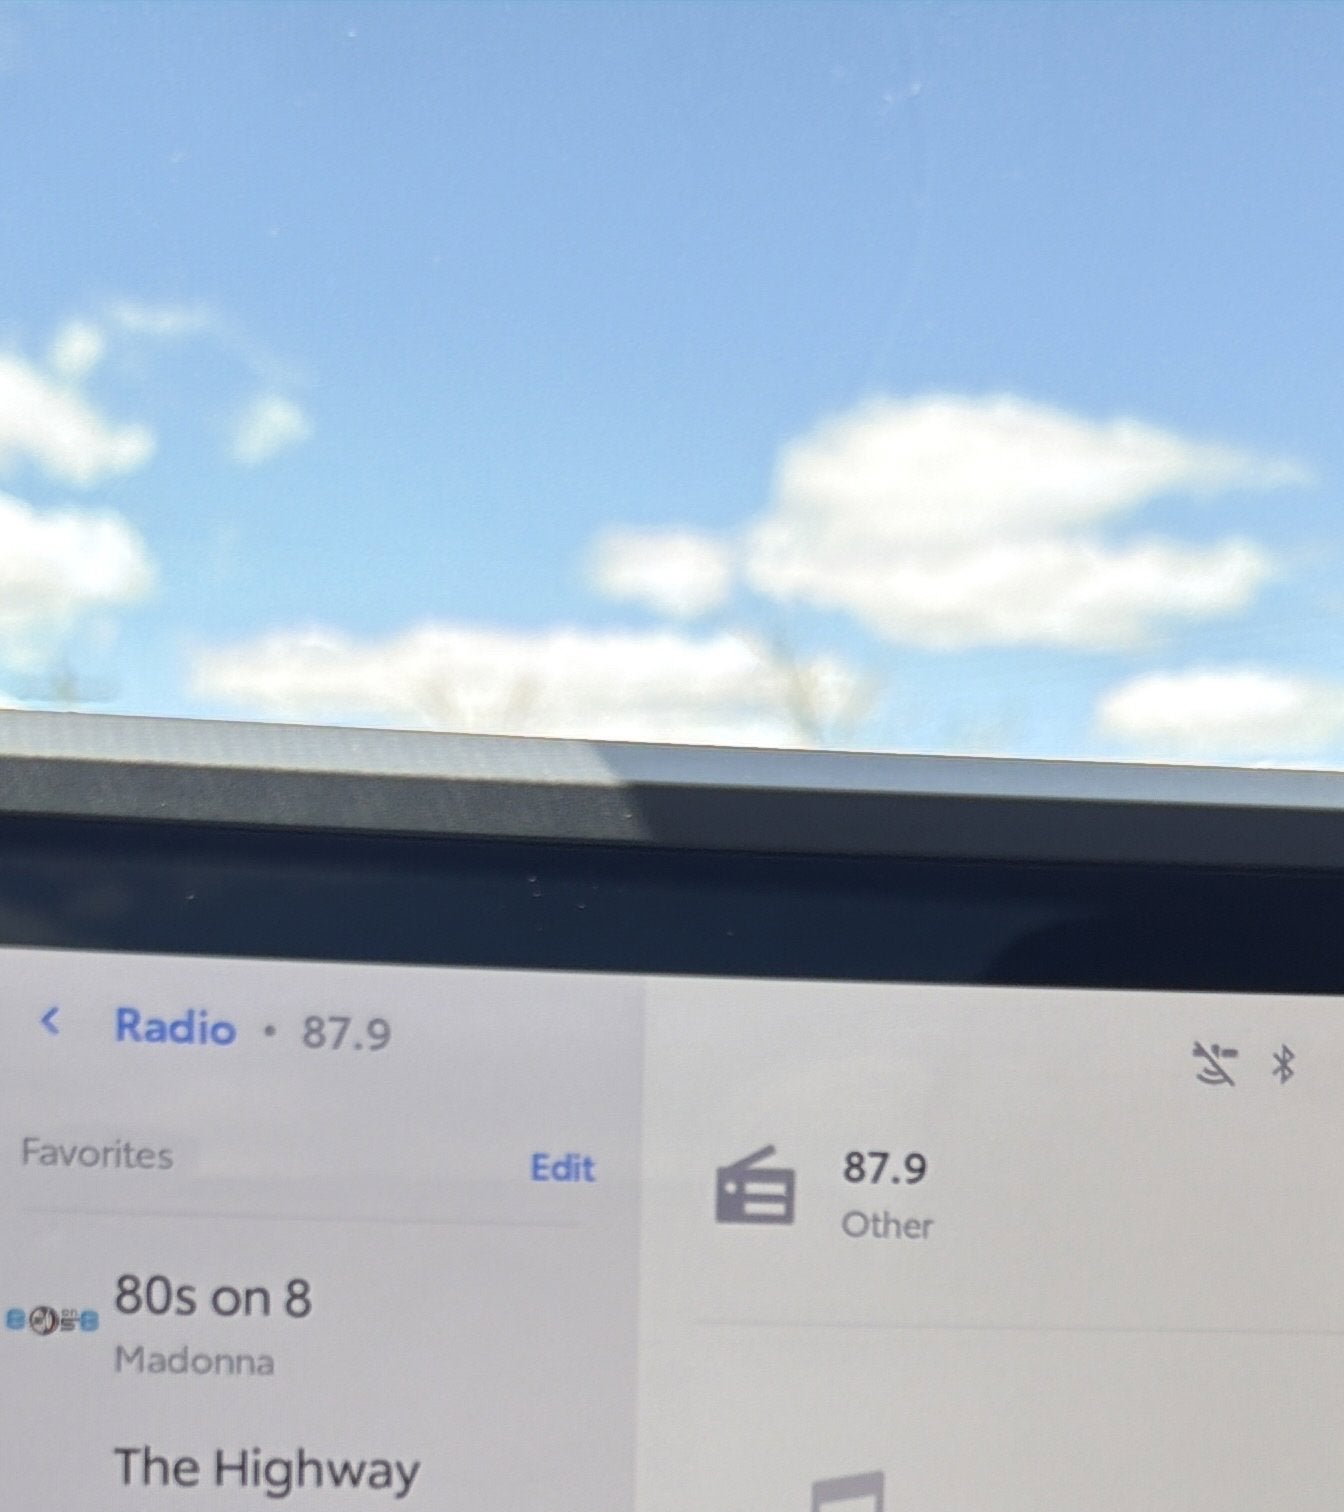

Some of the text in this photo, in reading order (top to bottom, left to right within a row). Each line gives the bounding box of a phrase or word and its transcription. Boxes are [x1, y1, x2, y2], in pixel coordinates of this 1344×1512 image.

[114, 1004, 393, 1053] Radio 87.9
[19, 1135, 175, 1172] Favorites
[529, 1151, 597, 1184] Edit
[842, 1150, 929, 1186] 87.9
[840, 1208, 935, 1241] Other
[114, 1274, 313, 1318] 80s on 8
[114, 1342, 276, 1378] Madonna
[113, 1445, 422, 1500] The Highway
